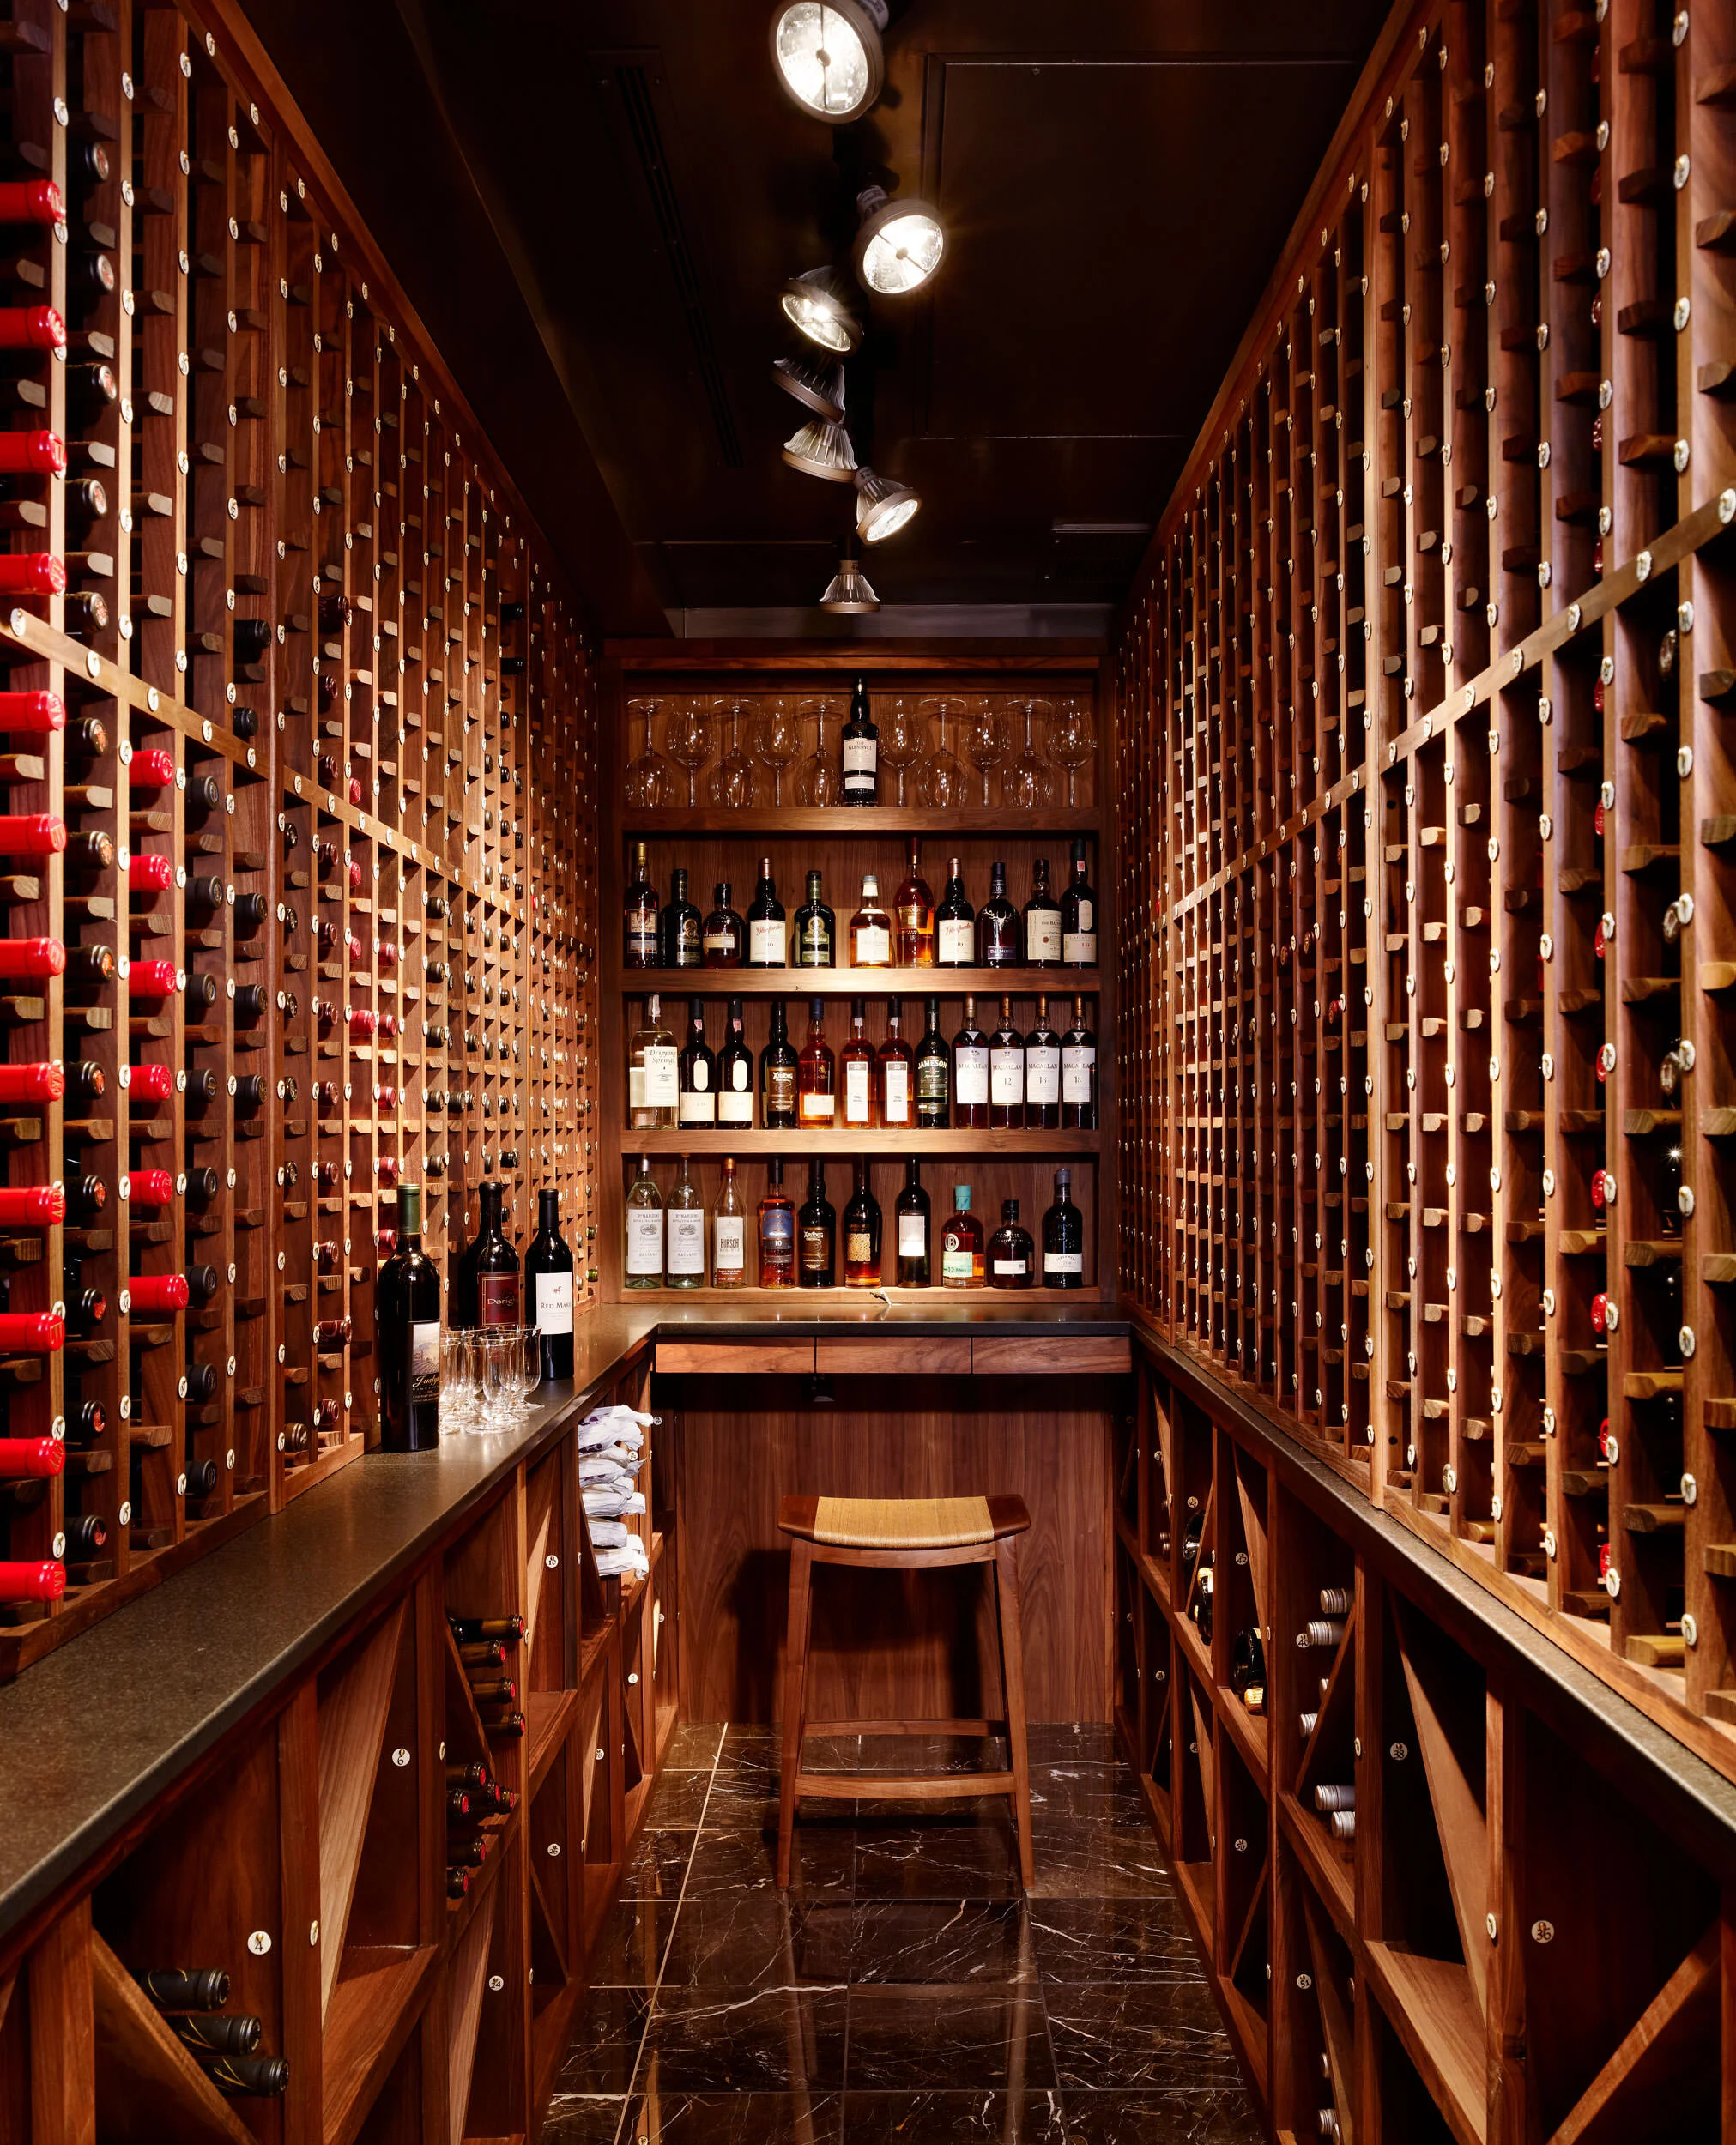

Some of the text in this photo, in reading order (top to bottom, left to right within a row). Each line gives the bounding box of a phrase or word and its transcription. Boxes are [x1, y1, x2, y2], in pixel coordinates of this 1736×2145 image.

[917, 1060, 948, 1070] JAMESON
[1003, 1077, 1013, 1085] 12
[720, 1238, 740, 1248] HIRSCH
[1394, 1749, 1405, 1759] 38
[396, 1755, 404, 1766] 6
[1536, 1926, 1552, 1941] 36
[254, 1940, 264, 1952] 4
[490, 1980, 501, 1989] 24
